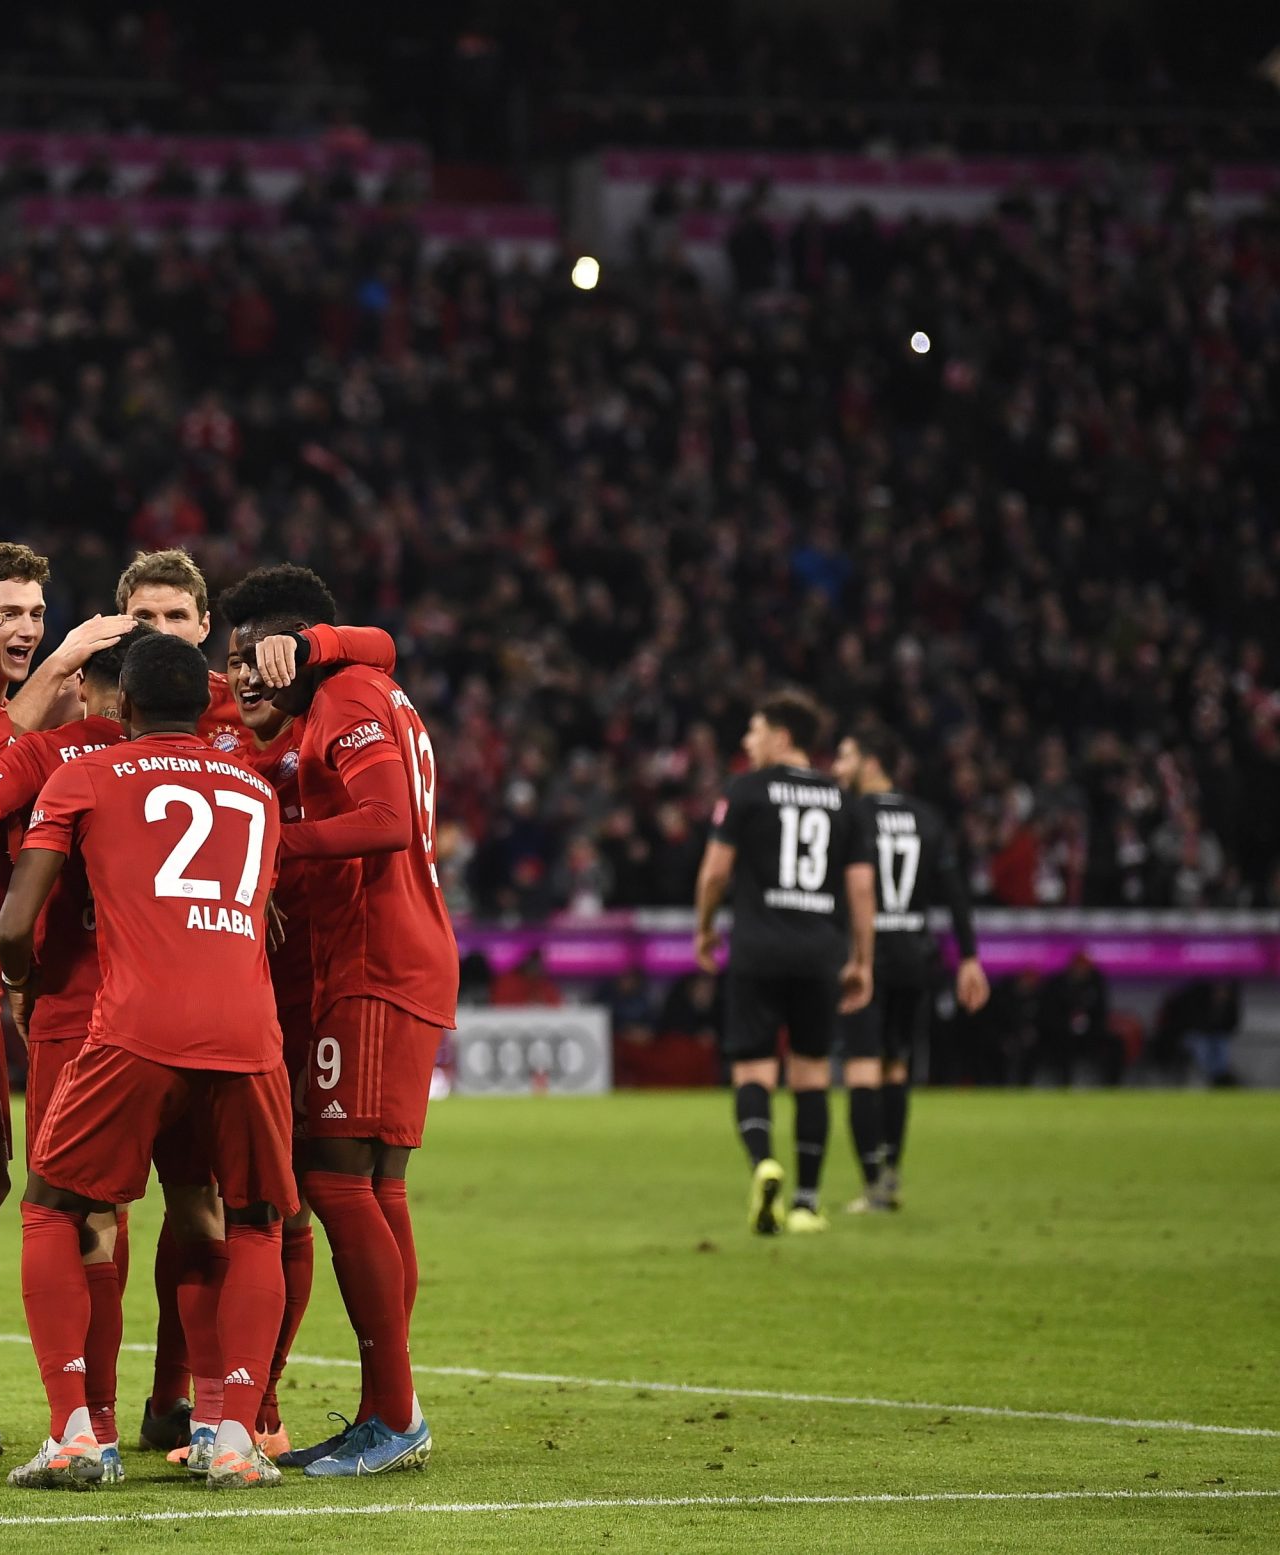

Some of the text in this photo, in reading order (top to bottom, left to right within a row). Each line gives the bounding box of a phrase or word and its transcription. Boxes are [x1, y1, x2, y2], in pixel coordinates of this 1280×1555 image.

[339, 721, 382, 747] QATAR
[354, 732, 385, 750] AIRWAYS
[112, 762, 137, 778] FC
[138, 756, 202, 773] BAYERN
[144, 784, 266, 907] 27
[778, 805, 832, 891] 13
[876, 833, 921, 913] 17
[187, 905, 256, 941] ALABA
